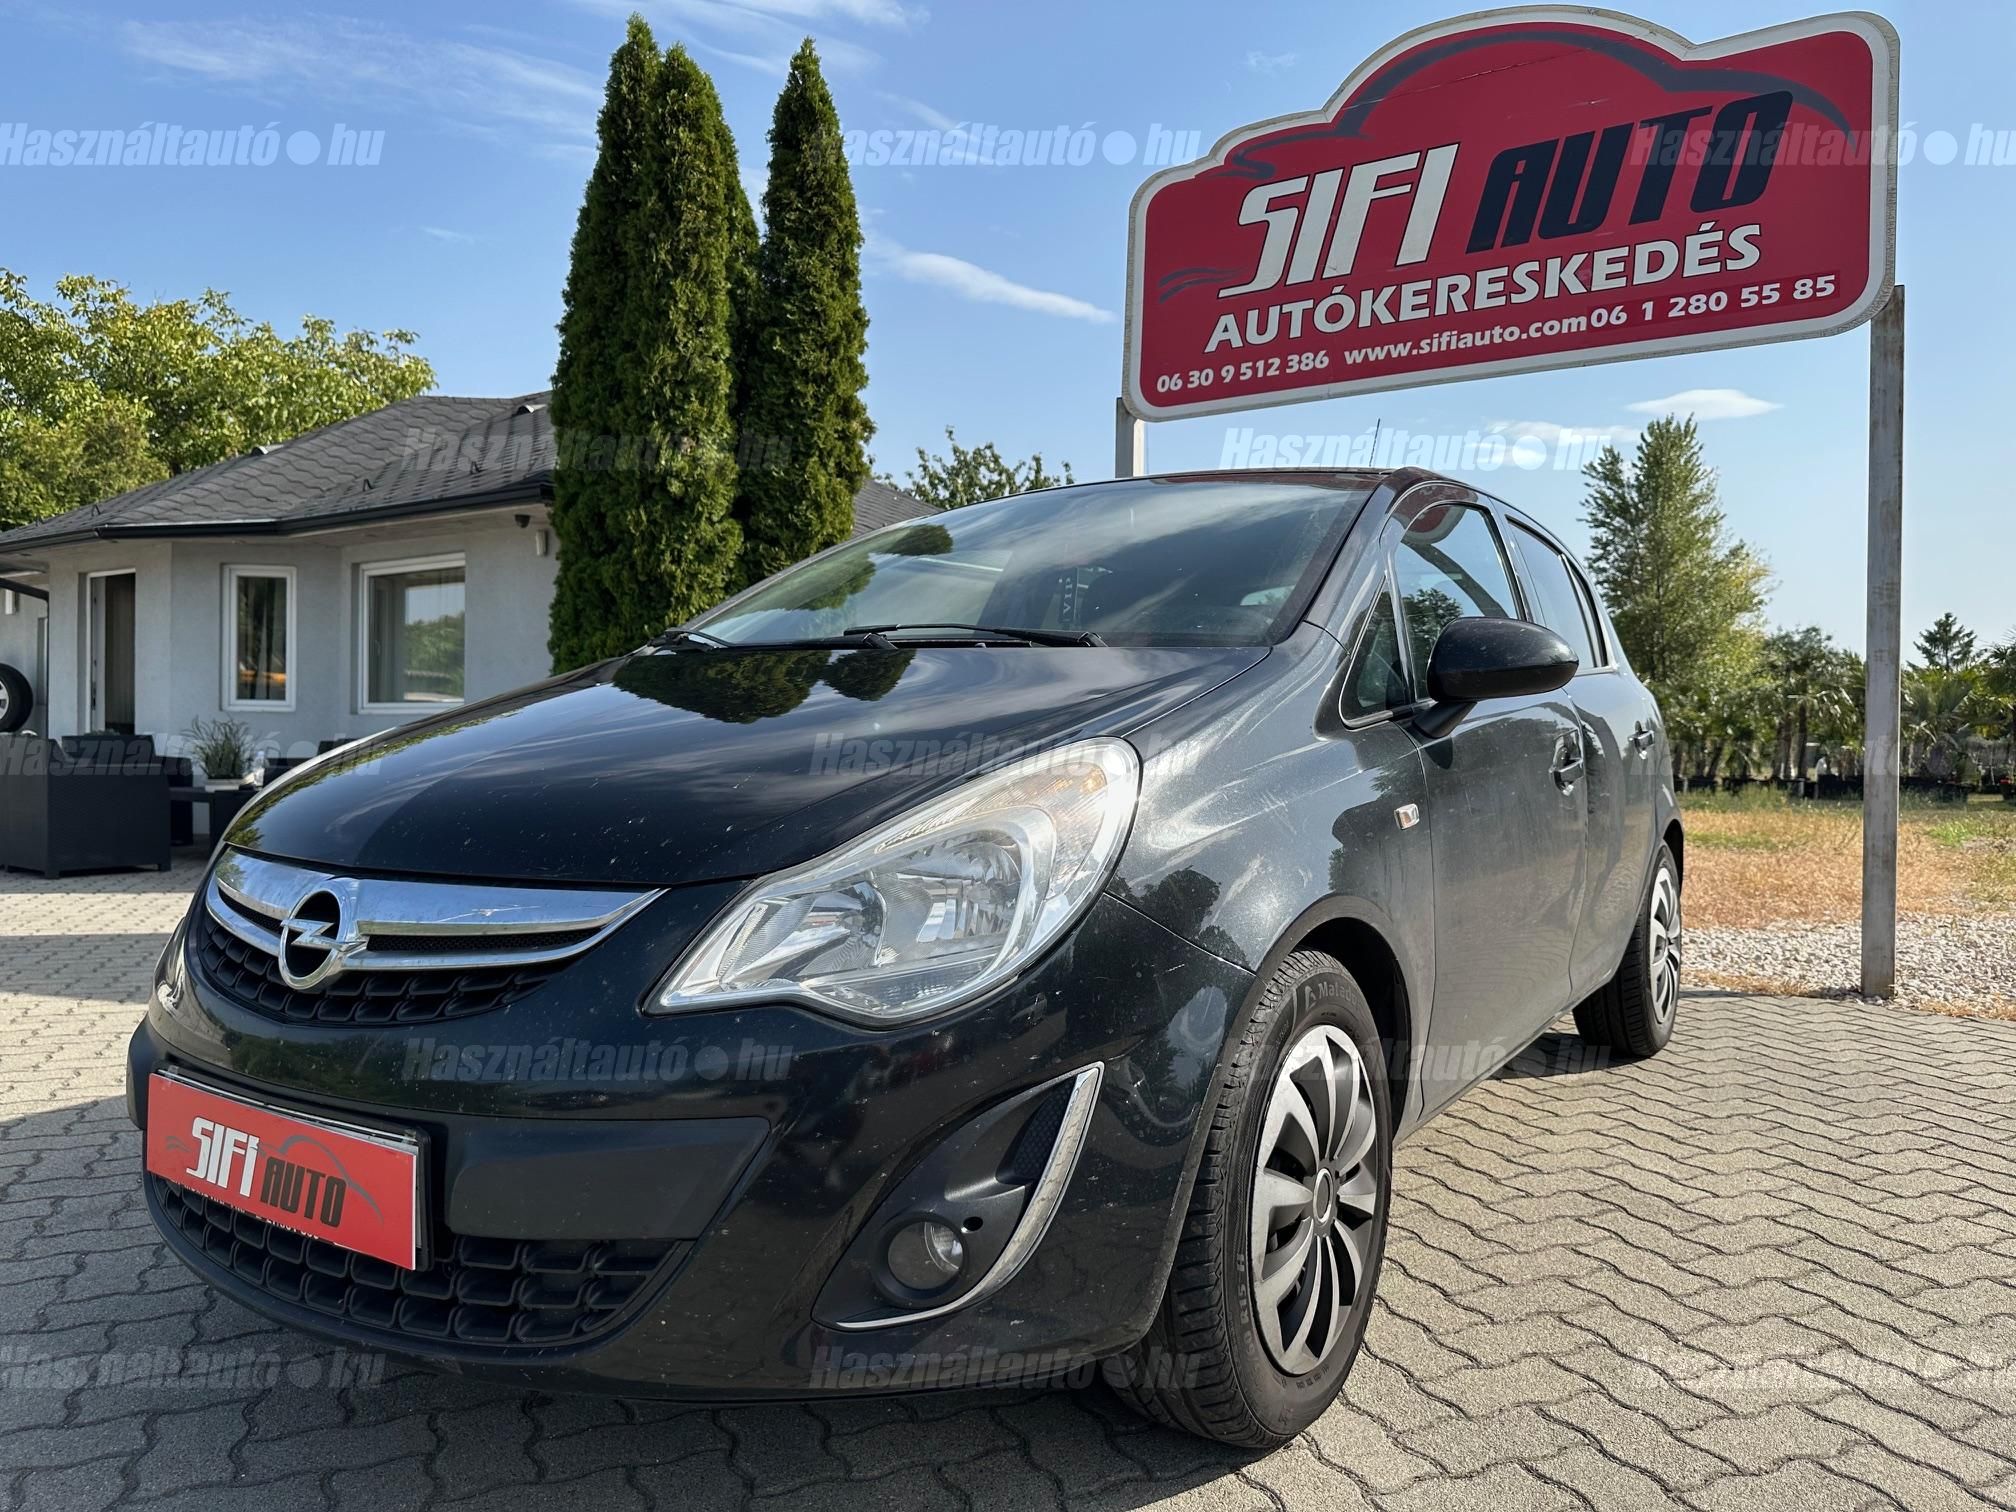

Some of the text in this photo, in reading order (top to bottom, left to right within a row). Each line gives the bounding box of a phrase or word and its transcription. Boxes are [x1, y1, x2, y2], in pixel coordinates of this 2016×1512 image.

[1217, 90, 1795, 300] SIFI AUTO
[1157, 275, 1836, 393] 06 30 9 512 386 www.sifiauto.com 06 1 280 55 85
[1203, 220, 1763, 354] AUTÓKERESKEDÉS
[186, 1116, 260, 1198] SIFI
[260, 1156, 348, 1229] AUTO
